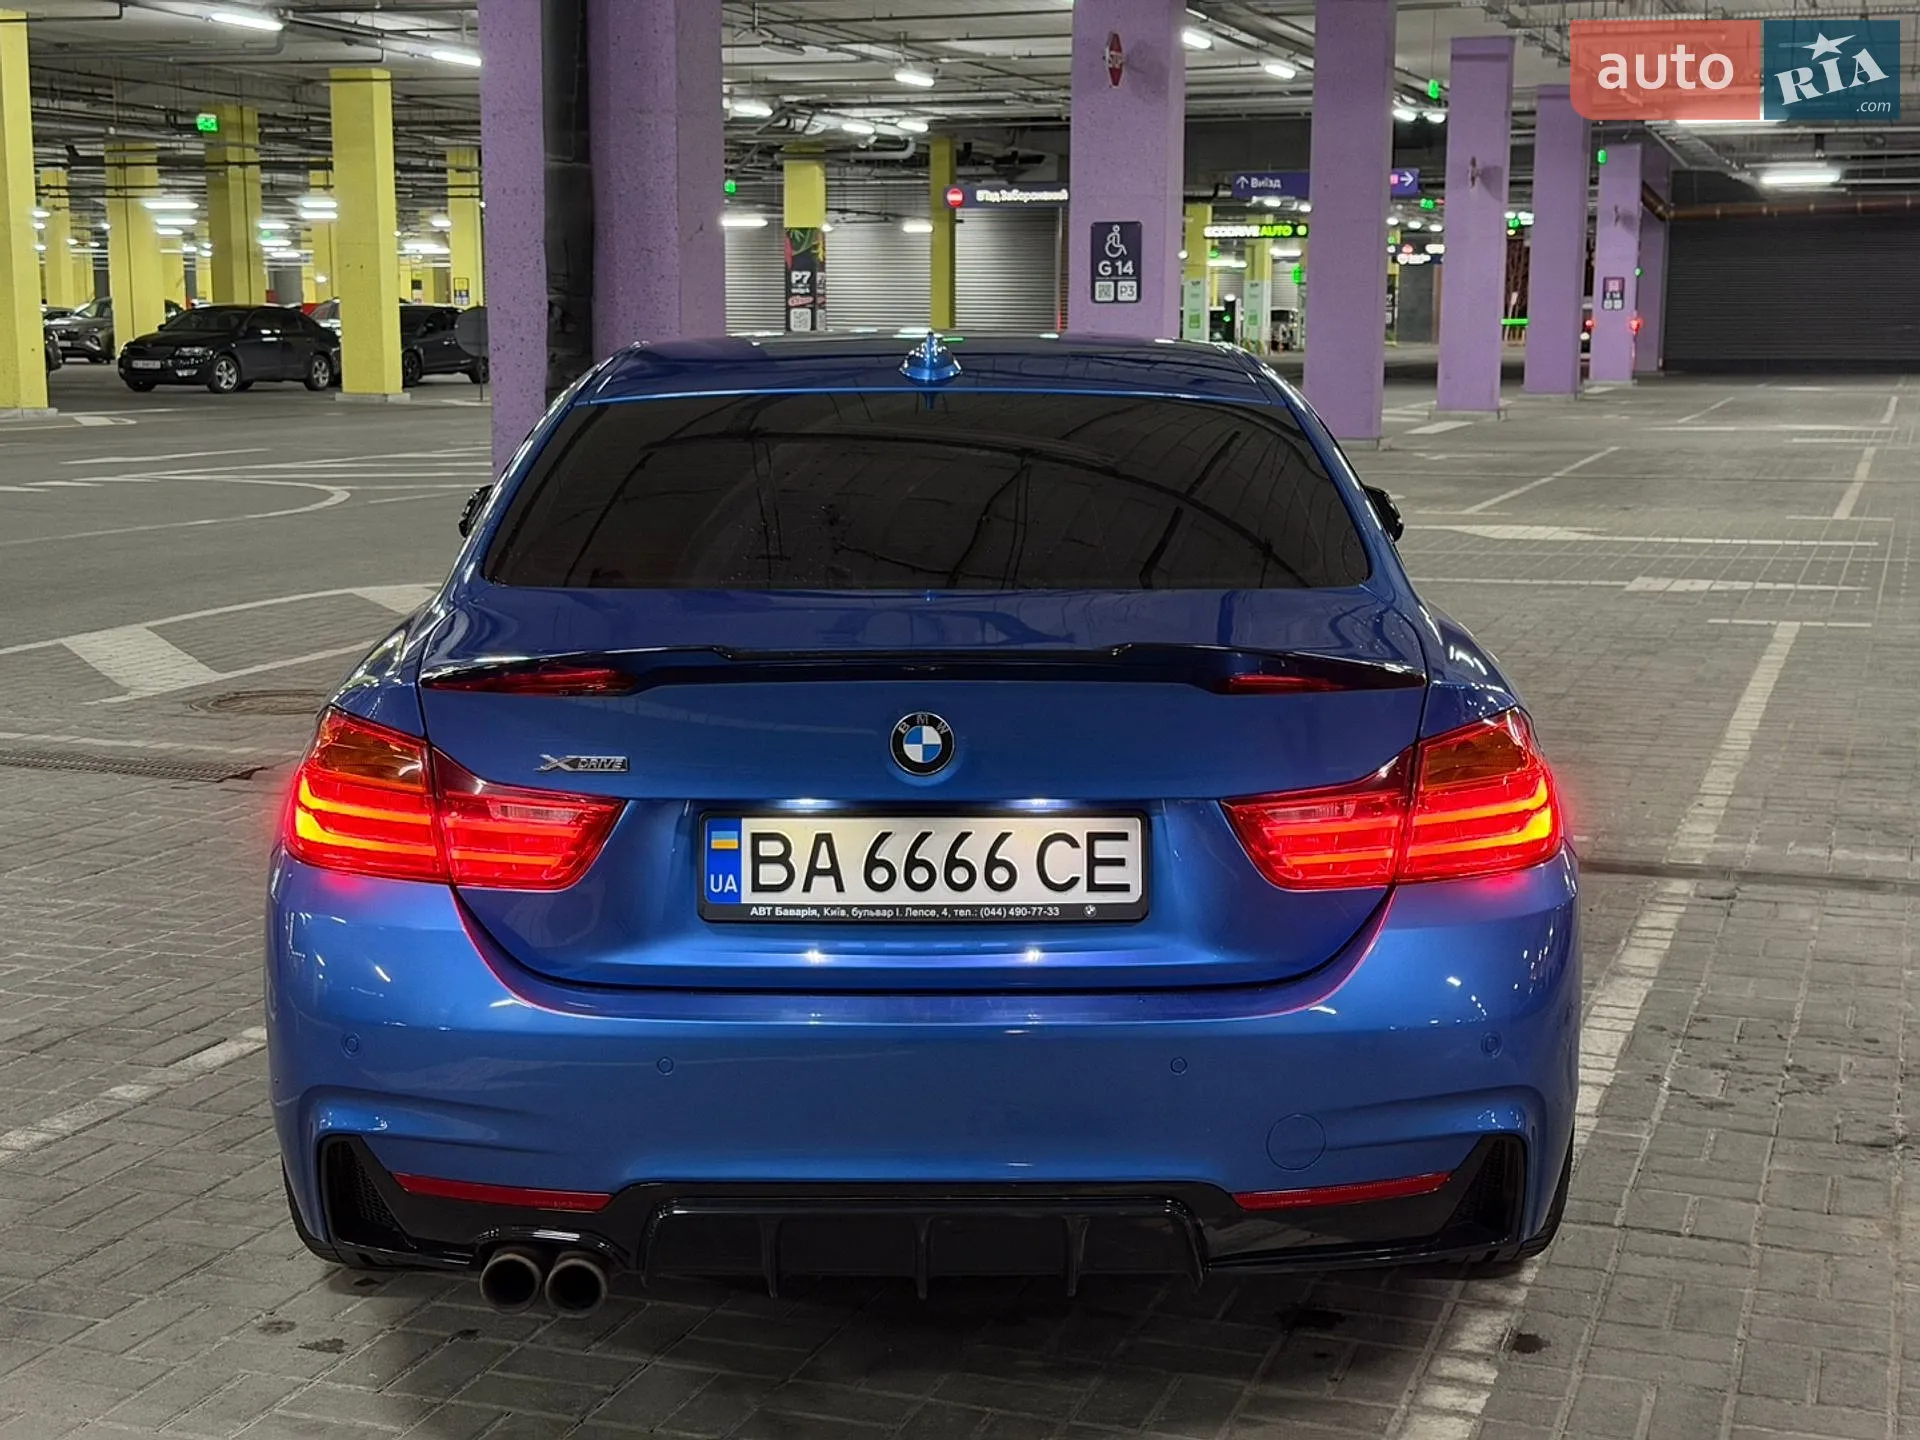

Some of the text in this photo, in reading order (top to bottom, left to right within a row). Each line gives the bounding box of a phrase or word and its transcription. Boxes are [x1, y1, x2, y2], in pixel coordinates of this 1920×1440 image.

[1098, 260, 1134, 276] G 14
[791, 270, 811, 284] P7
[1120, 286, 1135, 298] P3
[898, 714, 950, 735] BMW
[750, 831, 1131, 892] BA 6666 CE
[710, 873, 738, 892] UA
[750, 907, 773, 916] АВТ
[775, 907, 820, 918] Баварія,
[823, 907, 849, 918] Київ,
[852, 907, 893, 919] бульвар
[905, 908, 939, 918] Лепсе,
[941, 908, 951, 918] 4,
[980, 907, 1006, 919] (044)
[1008, 907, 1060, 917] 490-77-33
